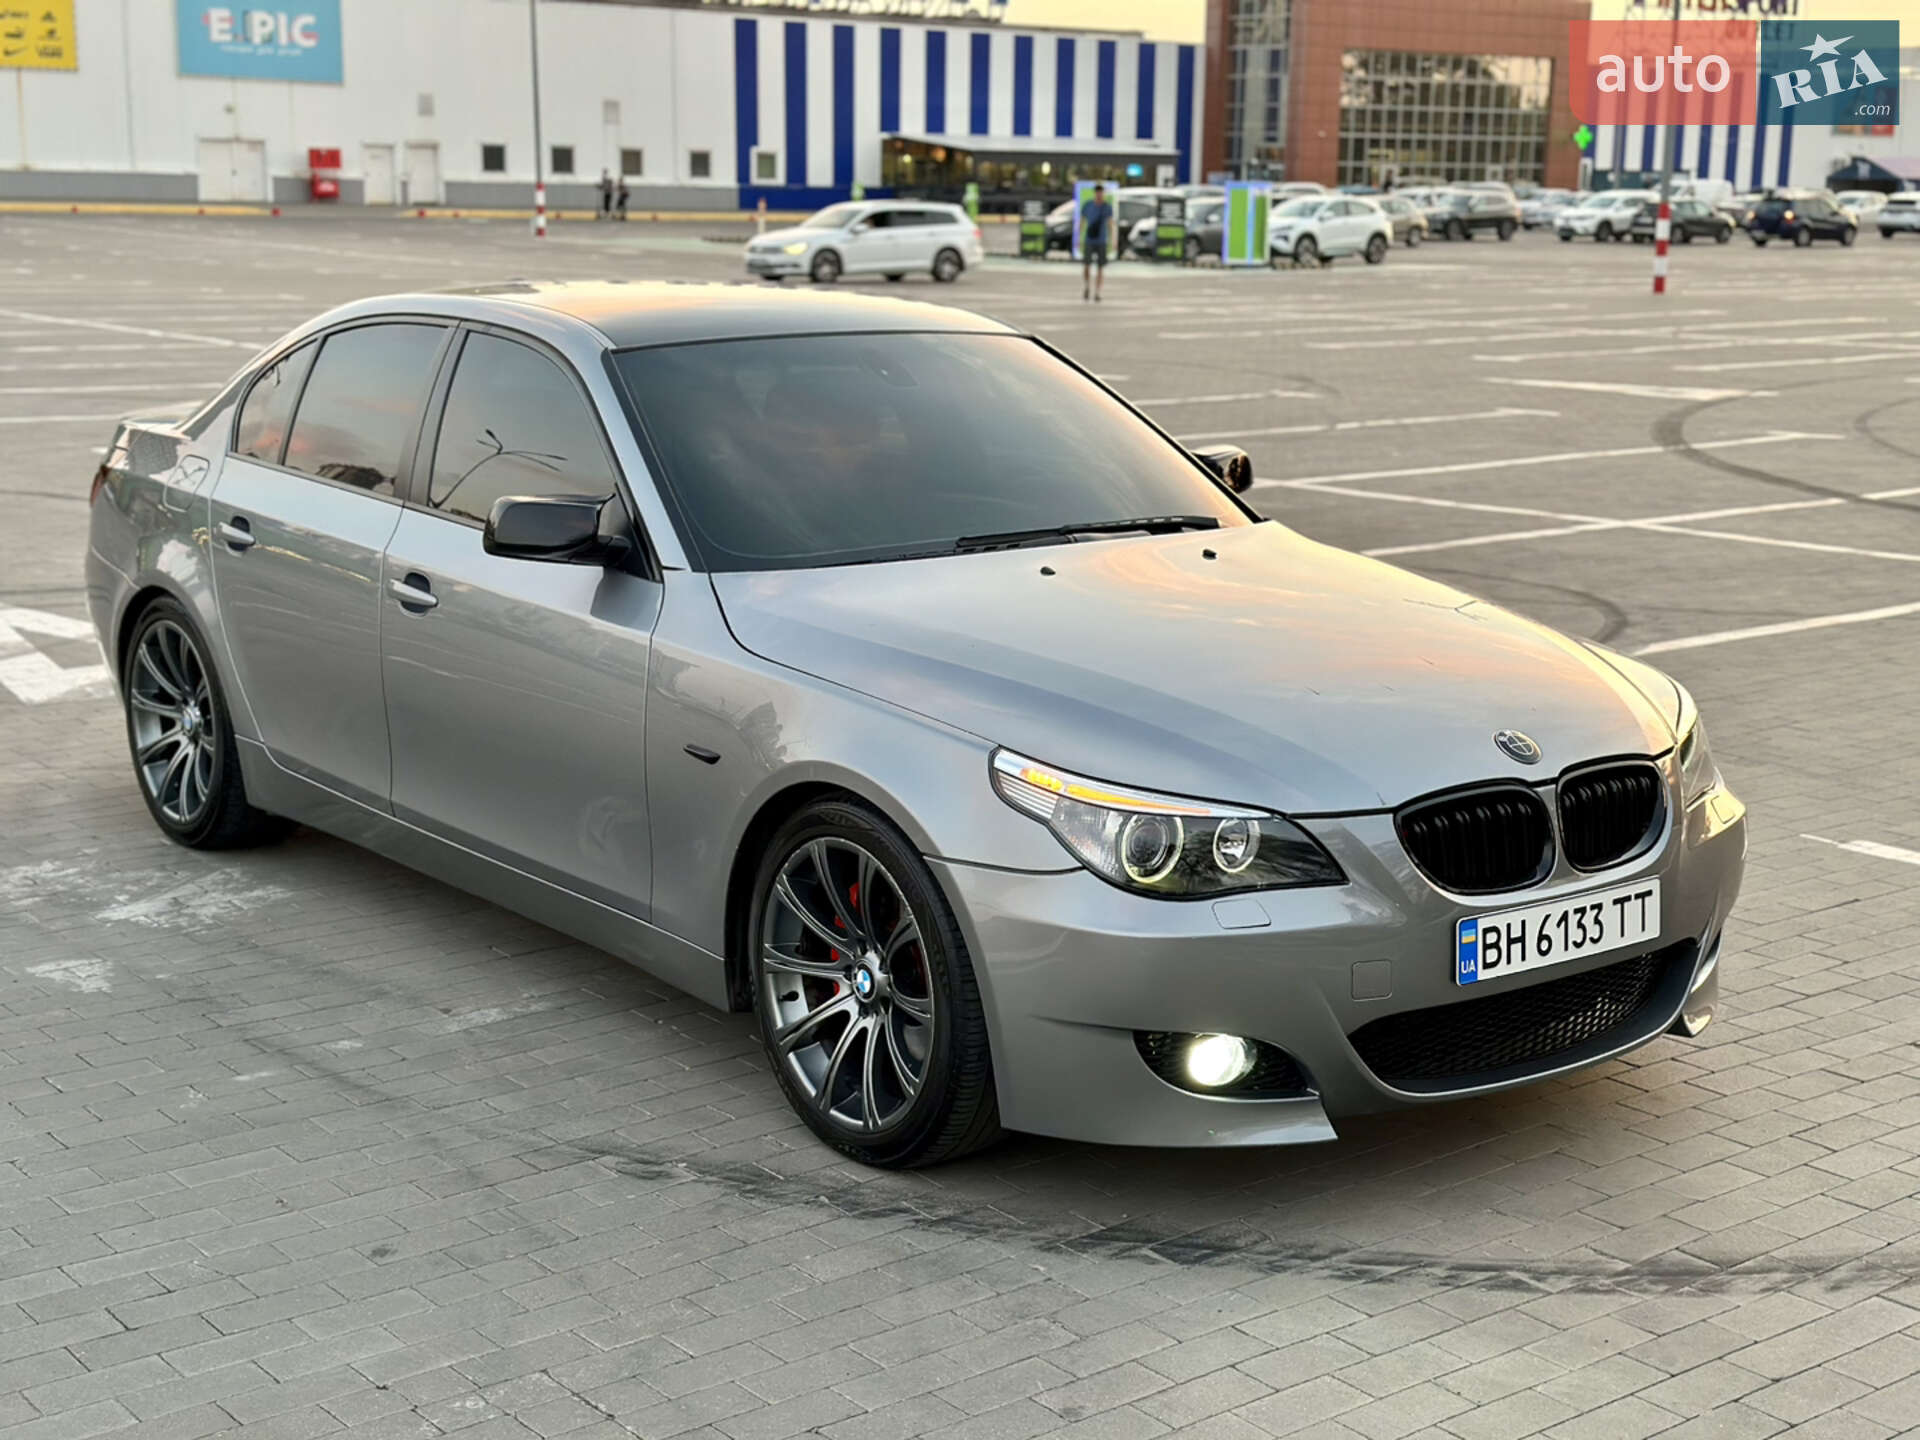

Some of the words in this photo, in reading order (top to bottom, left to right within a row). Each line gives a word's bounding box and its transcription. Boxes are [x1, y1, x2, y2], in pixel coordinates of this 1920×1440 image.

[1482, 919, 1526, 970] BH
[1536, 902, 1604, 957] 6133
[1612, 889, 1654, 938] TT
[1461, 960, 1476, 974] UA
